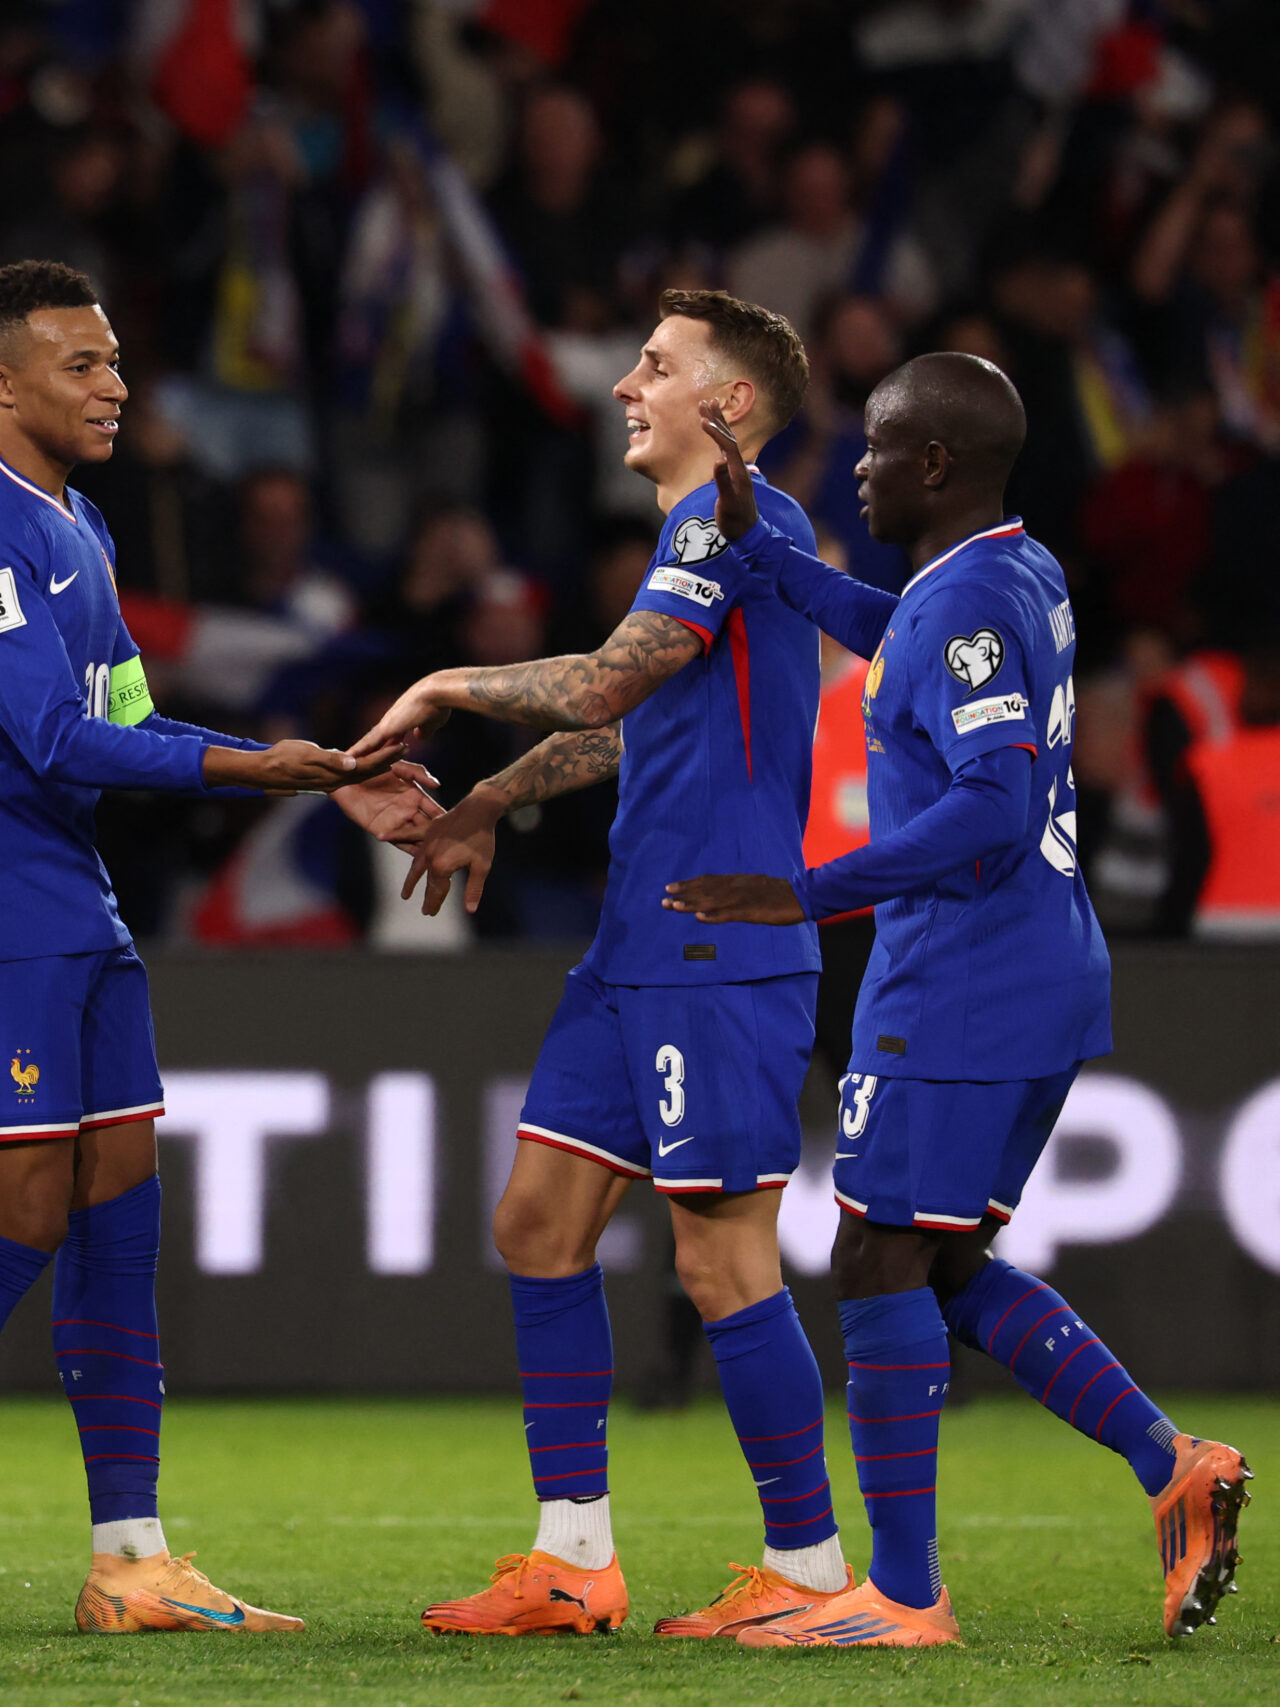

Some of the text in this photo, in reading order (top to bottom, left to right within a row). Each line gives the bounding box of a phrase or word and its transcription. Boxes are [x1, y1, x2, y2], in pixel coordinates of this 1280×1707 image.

[85, 662, 110, 719] 10
[118, 681, 149, 704] RESP
[655, 1044, 685, 1128] 3
